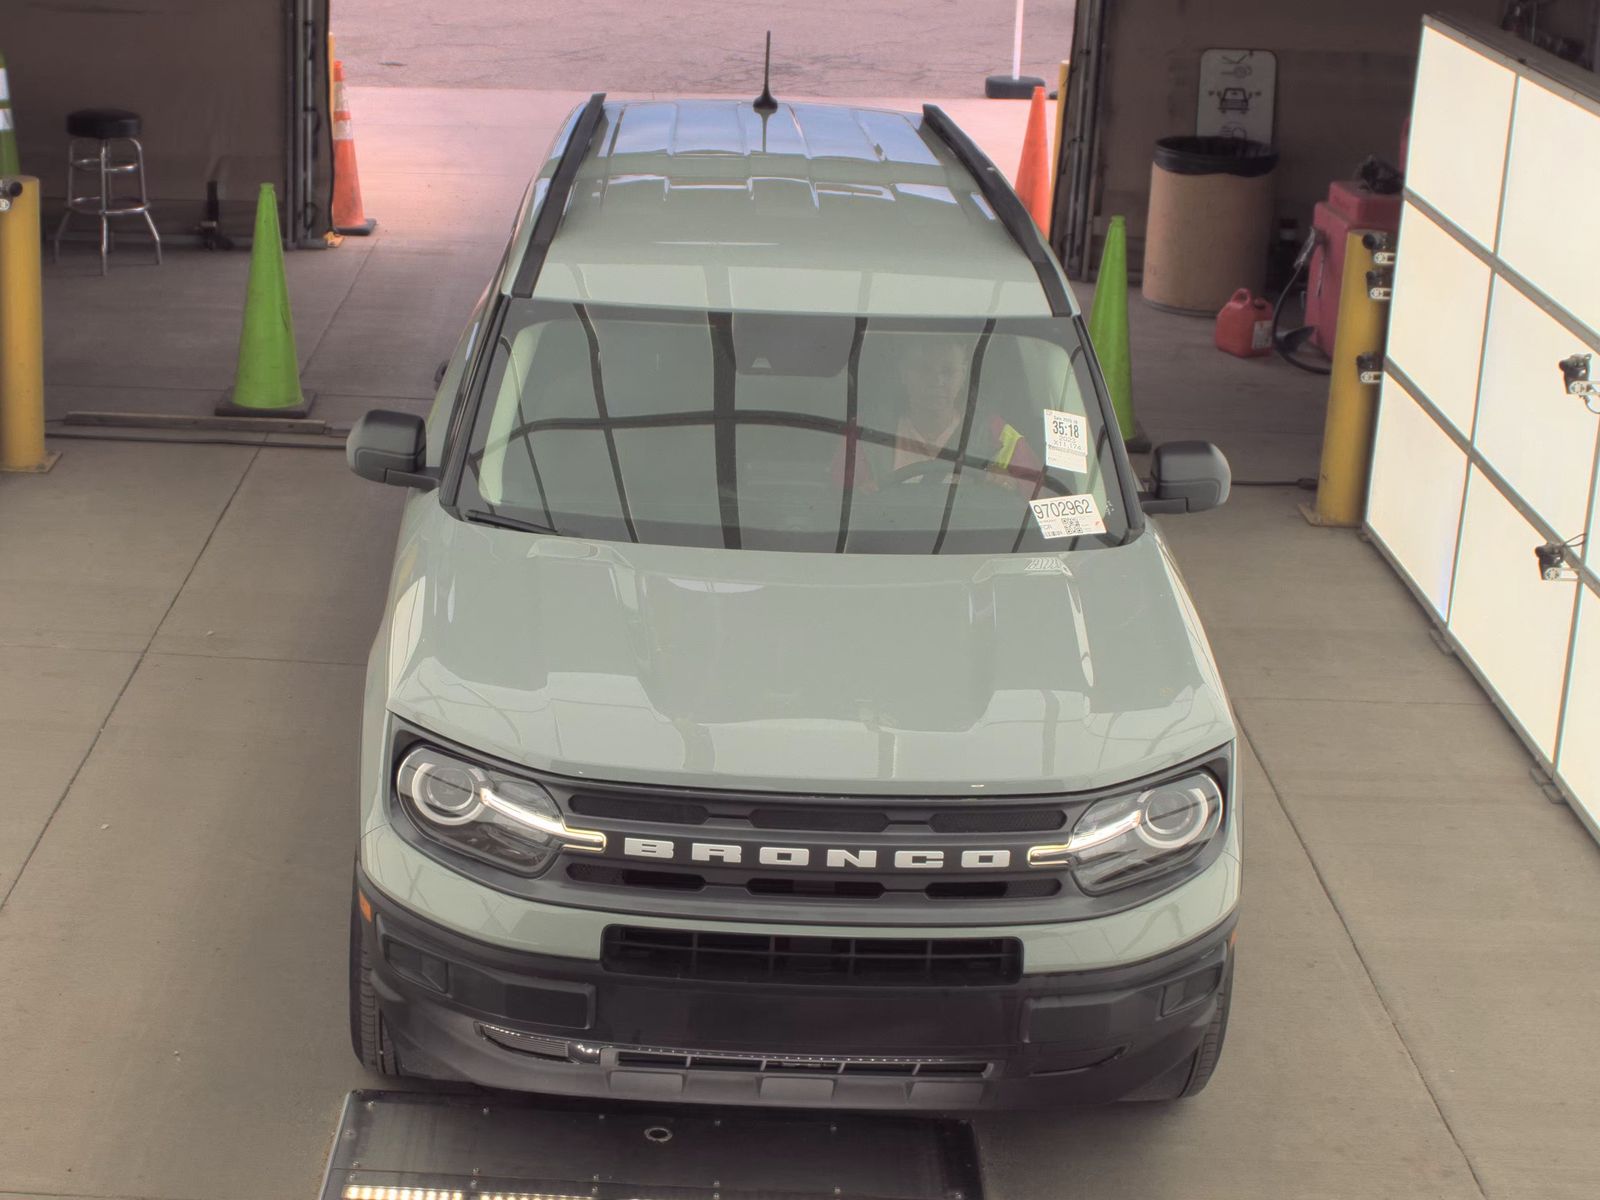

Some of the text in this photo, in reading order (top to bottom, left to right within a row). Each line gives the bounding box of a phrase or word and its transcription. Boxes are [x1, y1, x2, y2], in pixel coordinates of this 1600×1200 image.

[1052, 420, 1080, 439] 35:18
[1033, 499, 1093, 519] 9702962
[624, 837, 1011, 868] BRONCO
